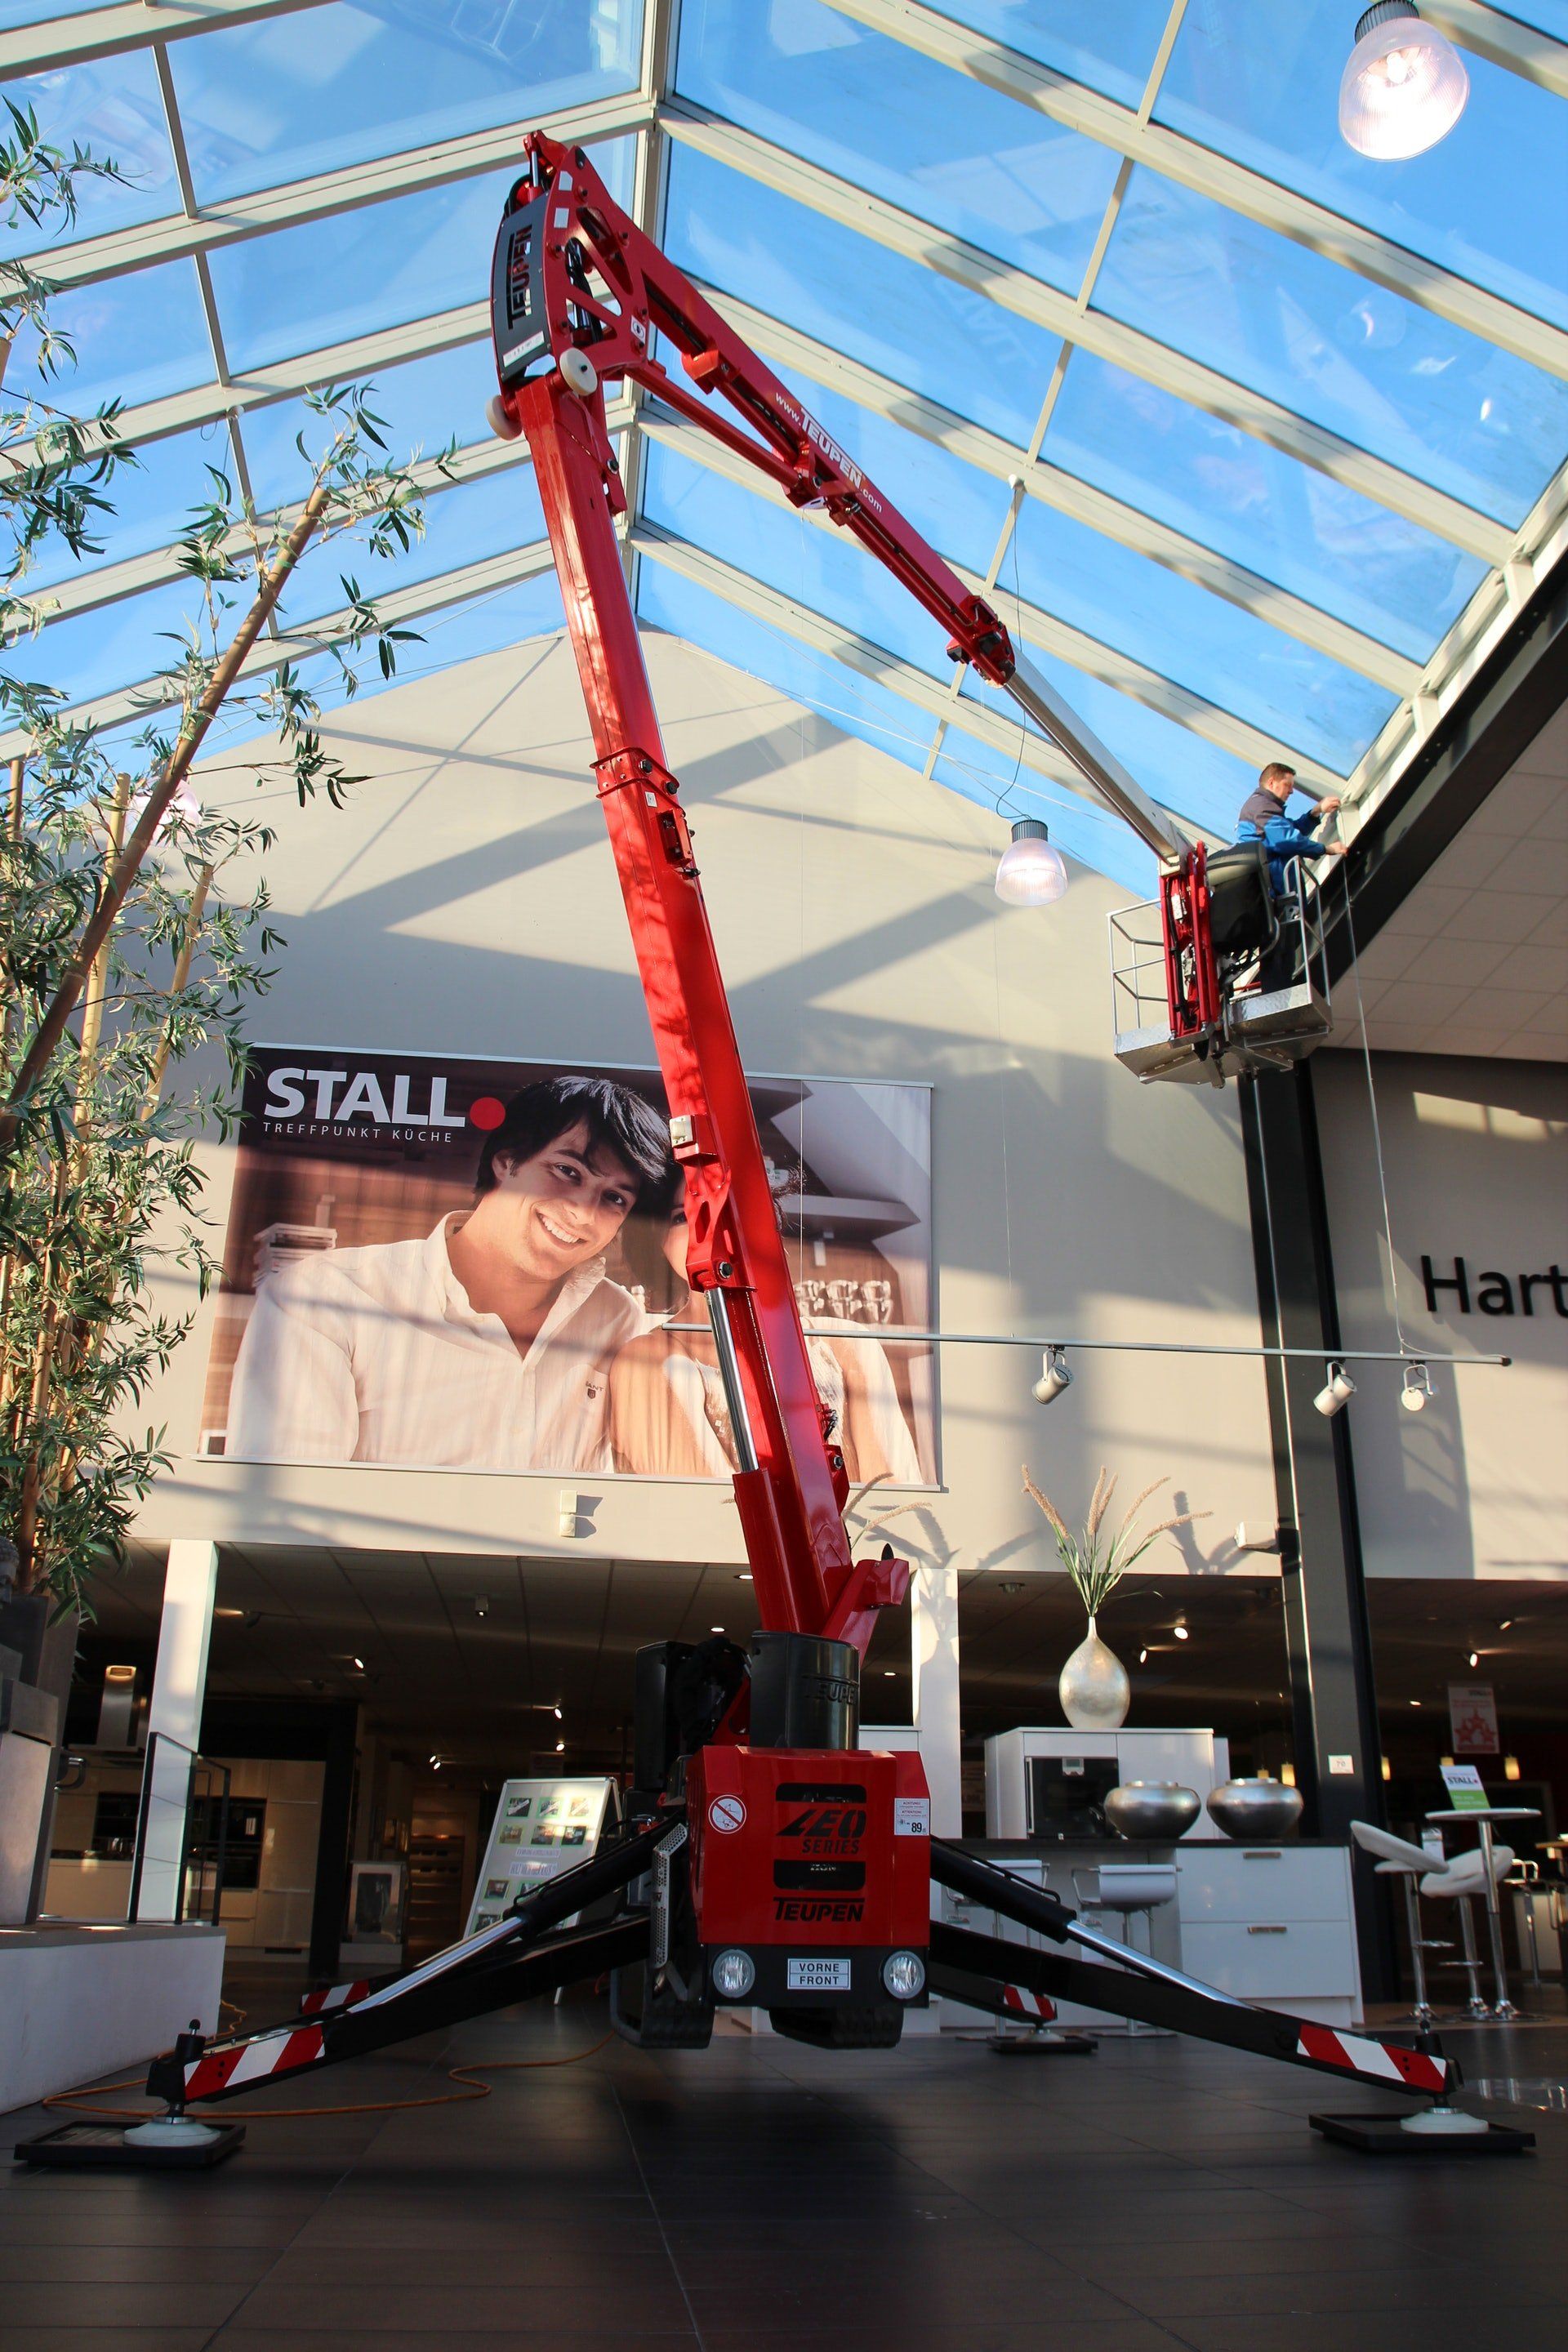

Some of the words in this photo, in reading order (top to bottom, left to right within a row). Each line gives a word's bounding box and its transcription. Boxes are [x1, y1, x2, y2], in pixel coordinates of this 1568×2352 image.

[506, 224, 532, 330] TEUPEN
[264, 1067, 466, 1128] STALL
[263, 1122, 381, 1139] TREFFPUNKT
[392, 1129, 452, 1143] KÜCHE
[1420, 1254, 1568, 1319] Hart
[776, 1809, 866, 1838] LEO
[911, 1822, 923, 1833] 89
[802, 1838, 860, 1855] SERIES
[773, 1895, 866, 1922] TEUPEN
[800, 1962, 840, 1972] VORNE
[800, 1976, 840, 1985] FRONT
